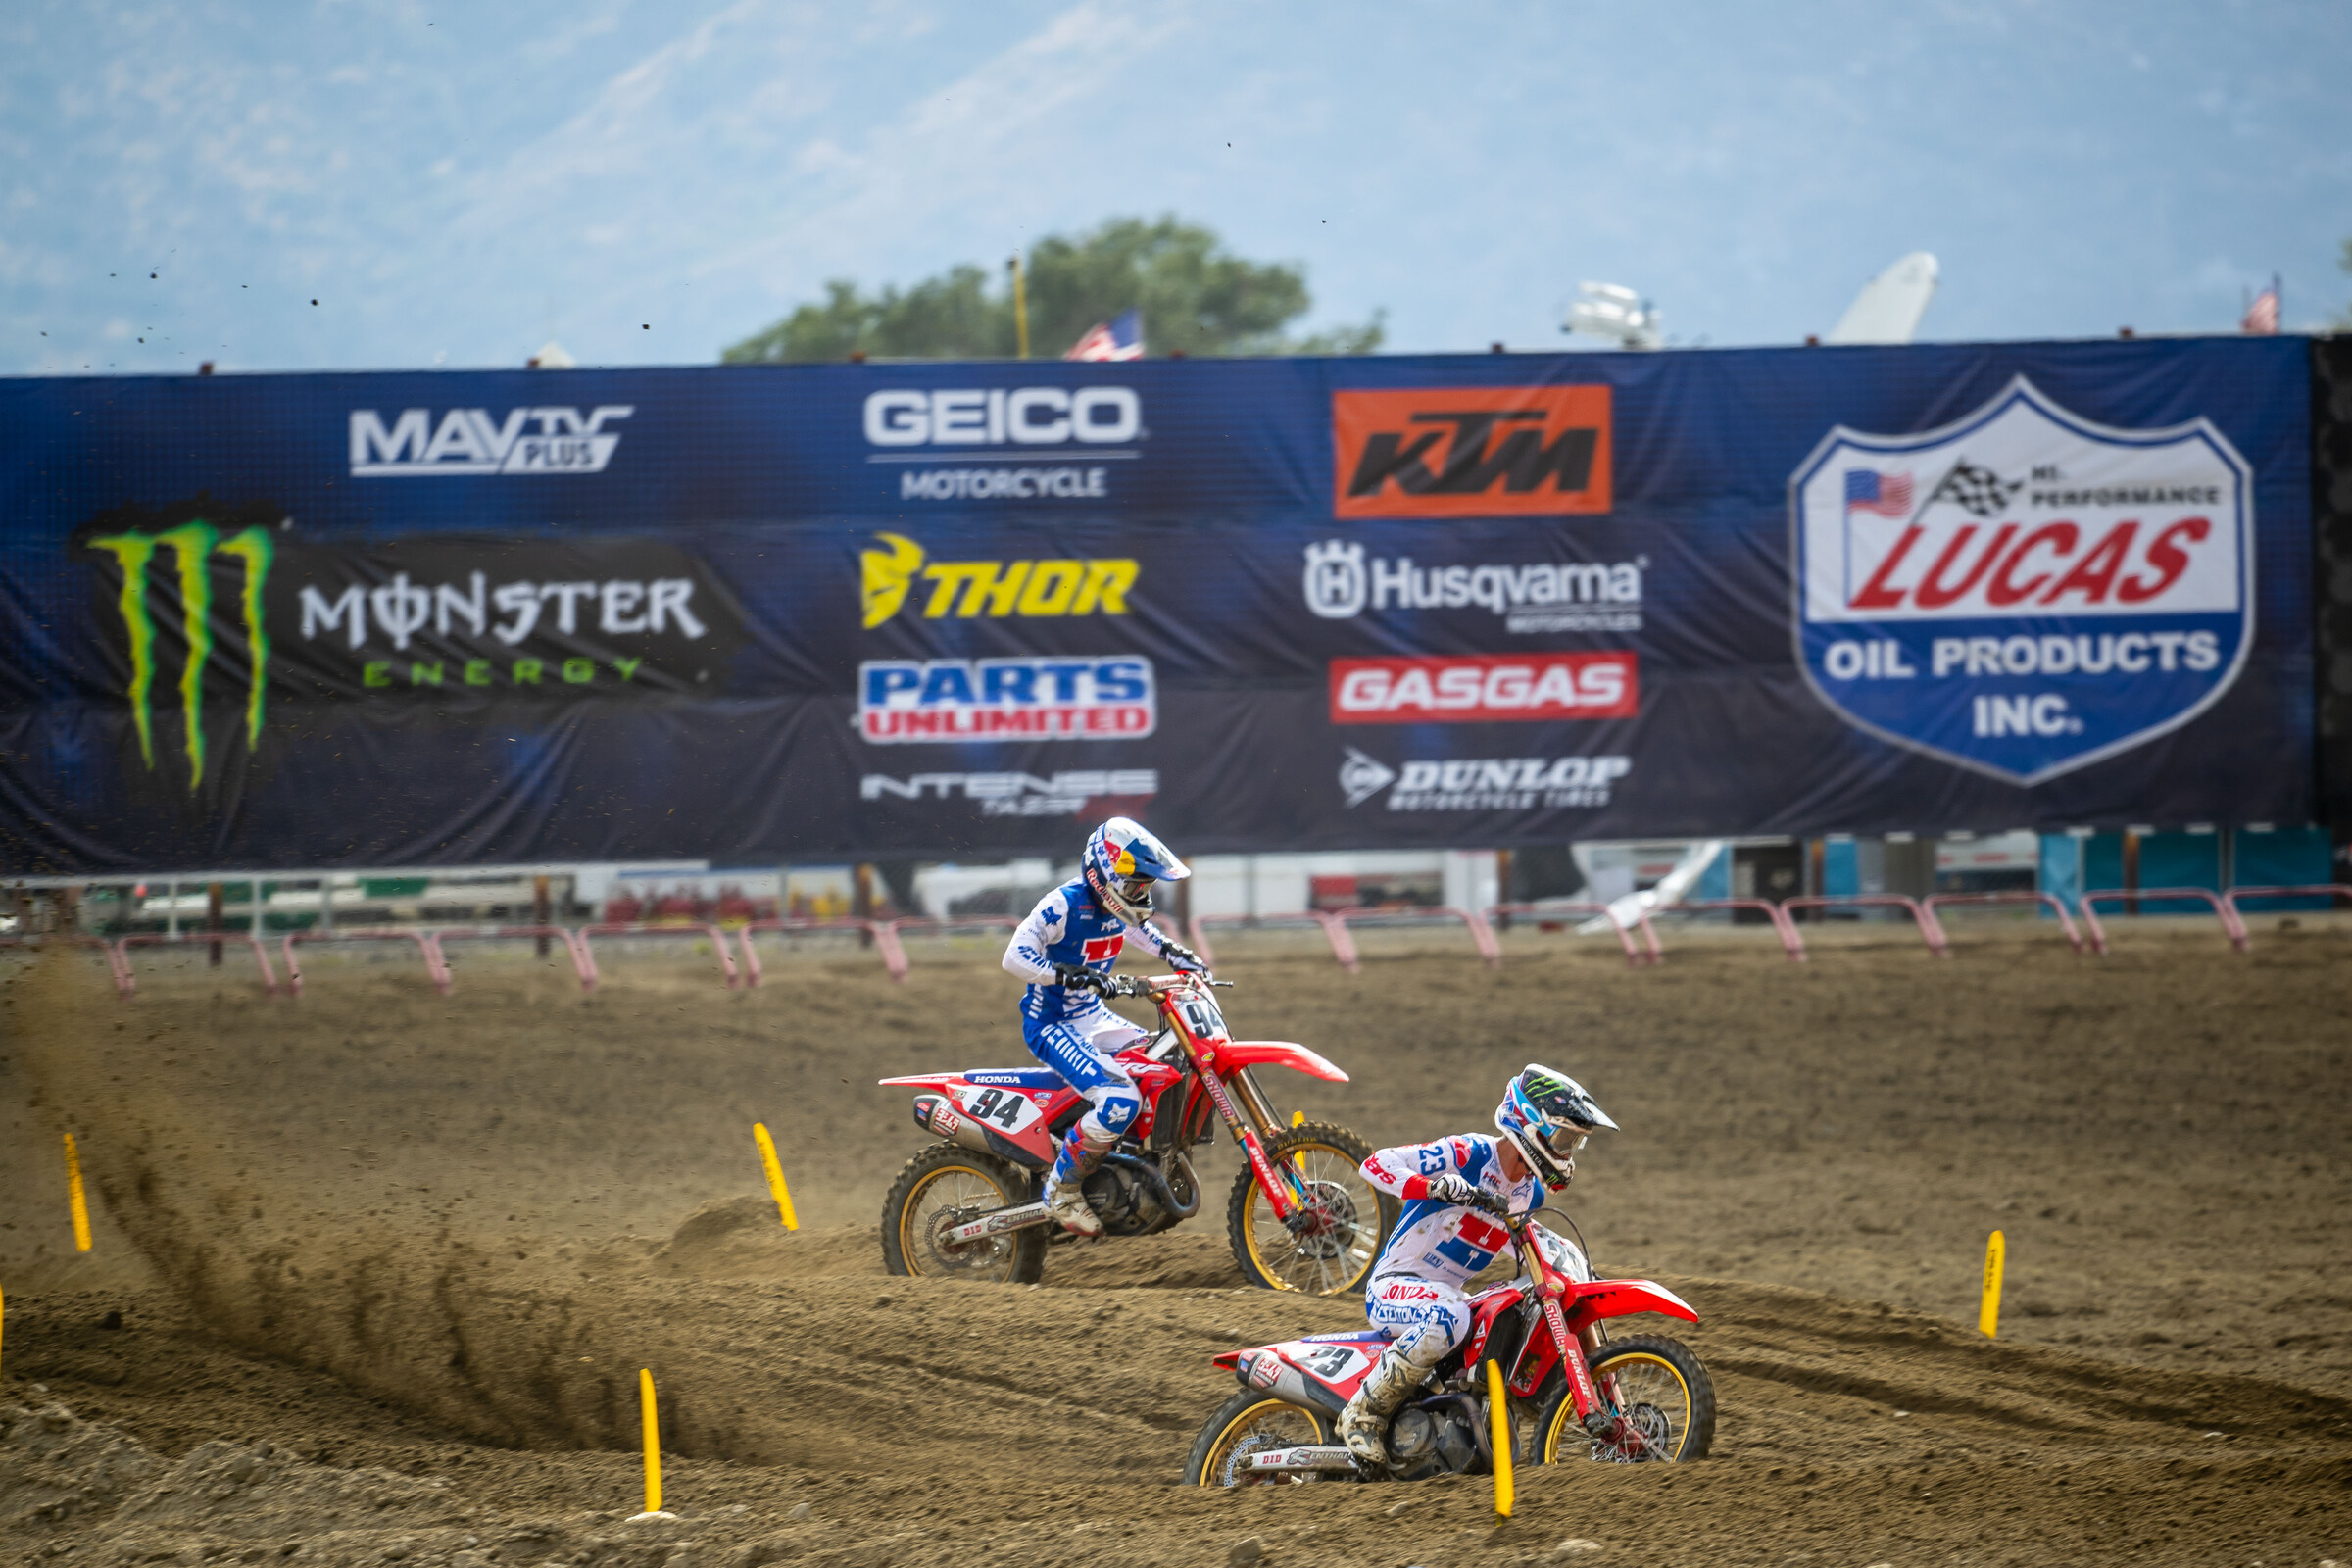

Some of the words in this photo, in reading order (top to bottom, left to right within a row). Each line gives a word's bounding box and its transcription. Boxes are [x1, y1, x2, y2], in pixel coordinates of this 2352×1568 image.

[349, 405, 635, 466] MAVTV
[863, 386, 1141, 447] GEICO
[523, 441, 594, 466] PLUS
[1347, 410, 1600, 498] KTM
[901, 466, 1107, 501] MOTORCYCLE
[2031, 486, 2222, 510] PERFORMANCE
[1847, 515, 2212, 611] LUCAS
[920, 558, 1141, 619] THOR
[1372, 556, 1642, 614] Husqvarna
[299, 570, 708, 650] MONSTER
[362, 657, 643, 687] ENERGY
[1824, 640, 1916, 679] OIL
[1932, 630, 2221, 677] PRODUCTS
[864, 661, 1151, 706] PARTS
[1338, 663, 1626, 711] GASGAS
[865, 705, 1150, 738] UNLIMITED
[859, 768, 1158, 800] INTENSE
[1394, 756, 1632, 792] DUNLOP
[1386, 790, 1538, 811] MOTORCYCLE
[1543, 788, 1610, 808] TIRES
[1086, 867, 1106, 895] Red
[1102, 889, 1124, 914] Bull
[1186, 1001, 1227, 1039] 94
[973, 1075, 1021, 1085] HONDA
[1202, 1075, 1237, 1120] SHOWA
[968, 1088, 1025, 1129] 94
[1249, 1146, 1284, 1199] DUNLOP
[1418, 1145, 1447, 1176] 23
[963, 1225, 982, 1237] DID
[1310, 1332, 1359, 1342] HONDA
[1544, 1303, 1566, 1348] SHOWA
[1293, 1345, 1355, 1378] 23
[1567, 1348, 1592, 1399] DUNLOP
[1261, 1454, 1283, 1465] DID
[1286, 1448, 1350, 1466] RENTHAL
